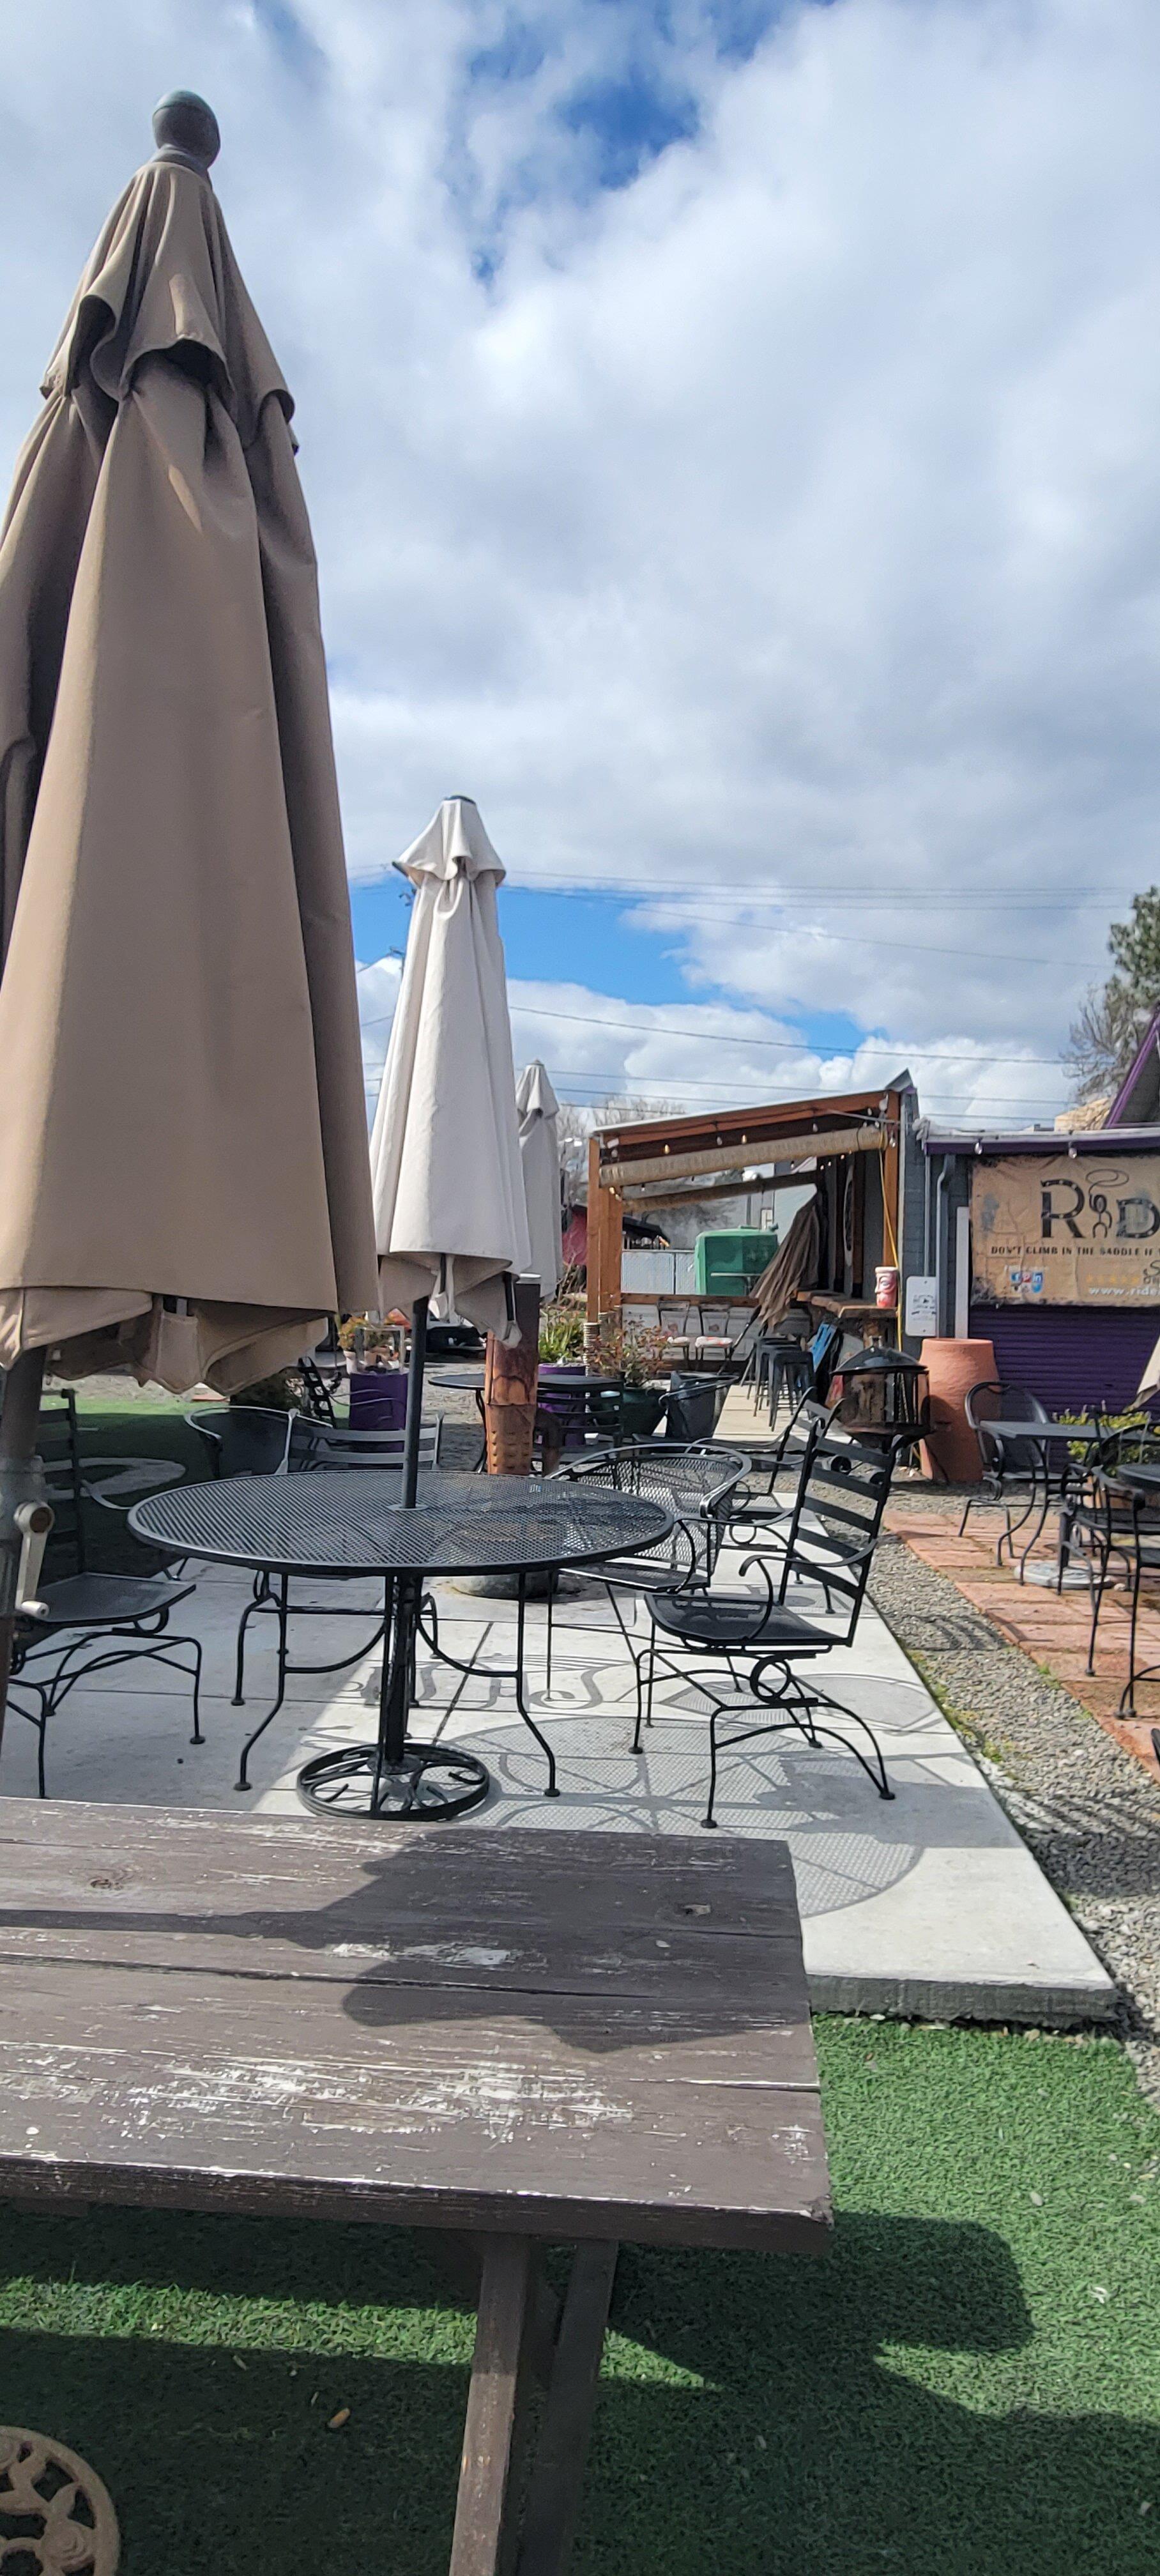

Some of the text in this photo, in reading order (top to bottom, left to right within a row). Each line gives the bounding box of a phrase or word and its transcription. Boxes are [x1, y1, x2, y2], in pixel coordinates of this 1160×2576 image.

[991, 1246, 1021, 1255] DON'T
[1025, 1246, 1058, 1255] CLIMB
[1062, 1246, 1072, 1255] IN
